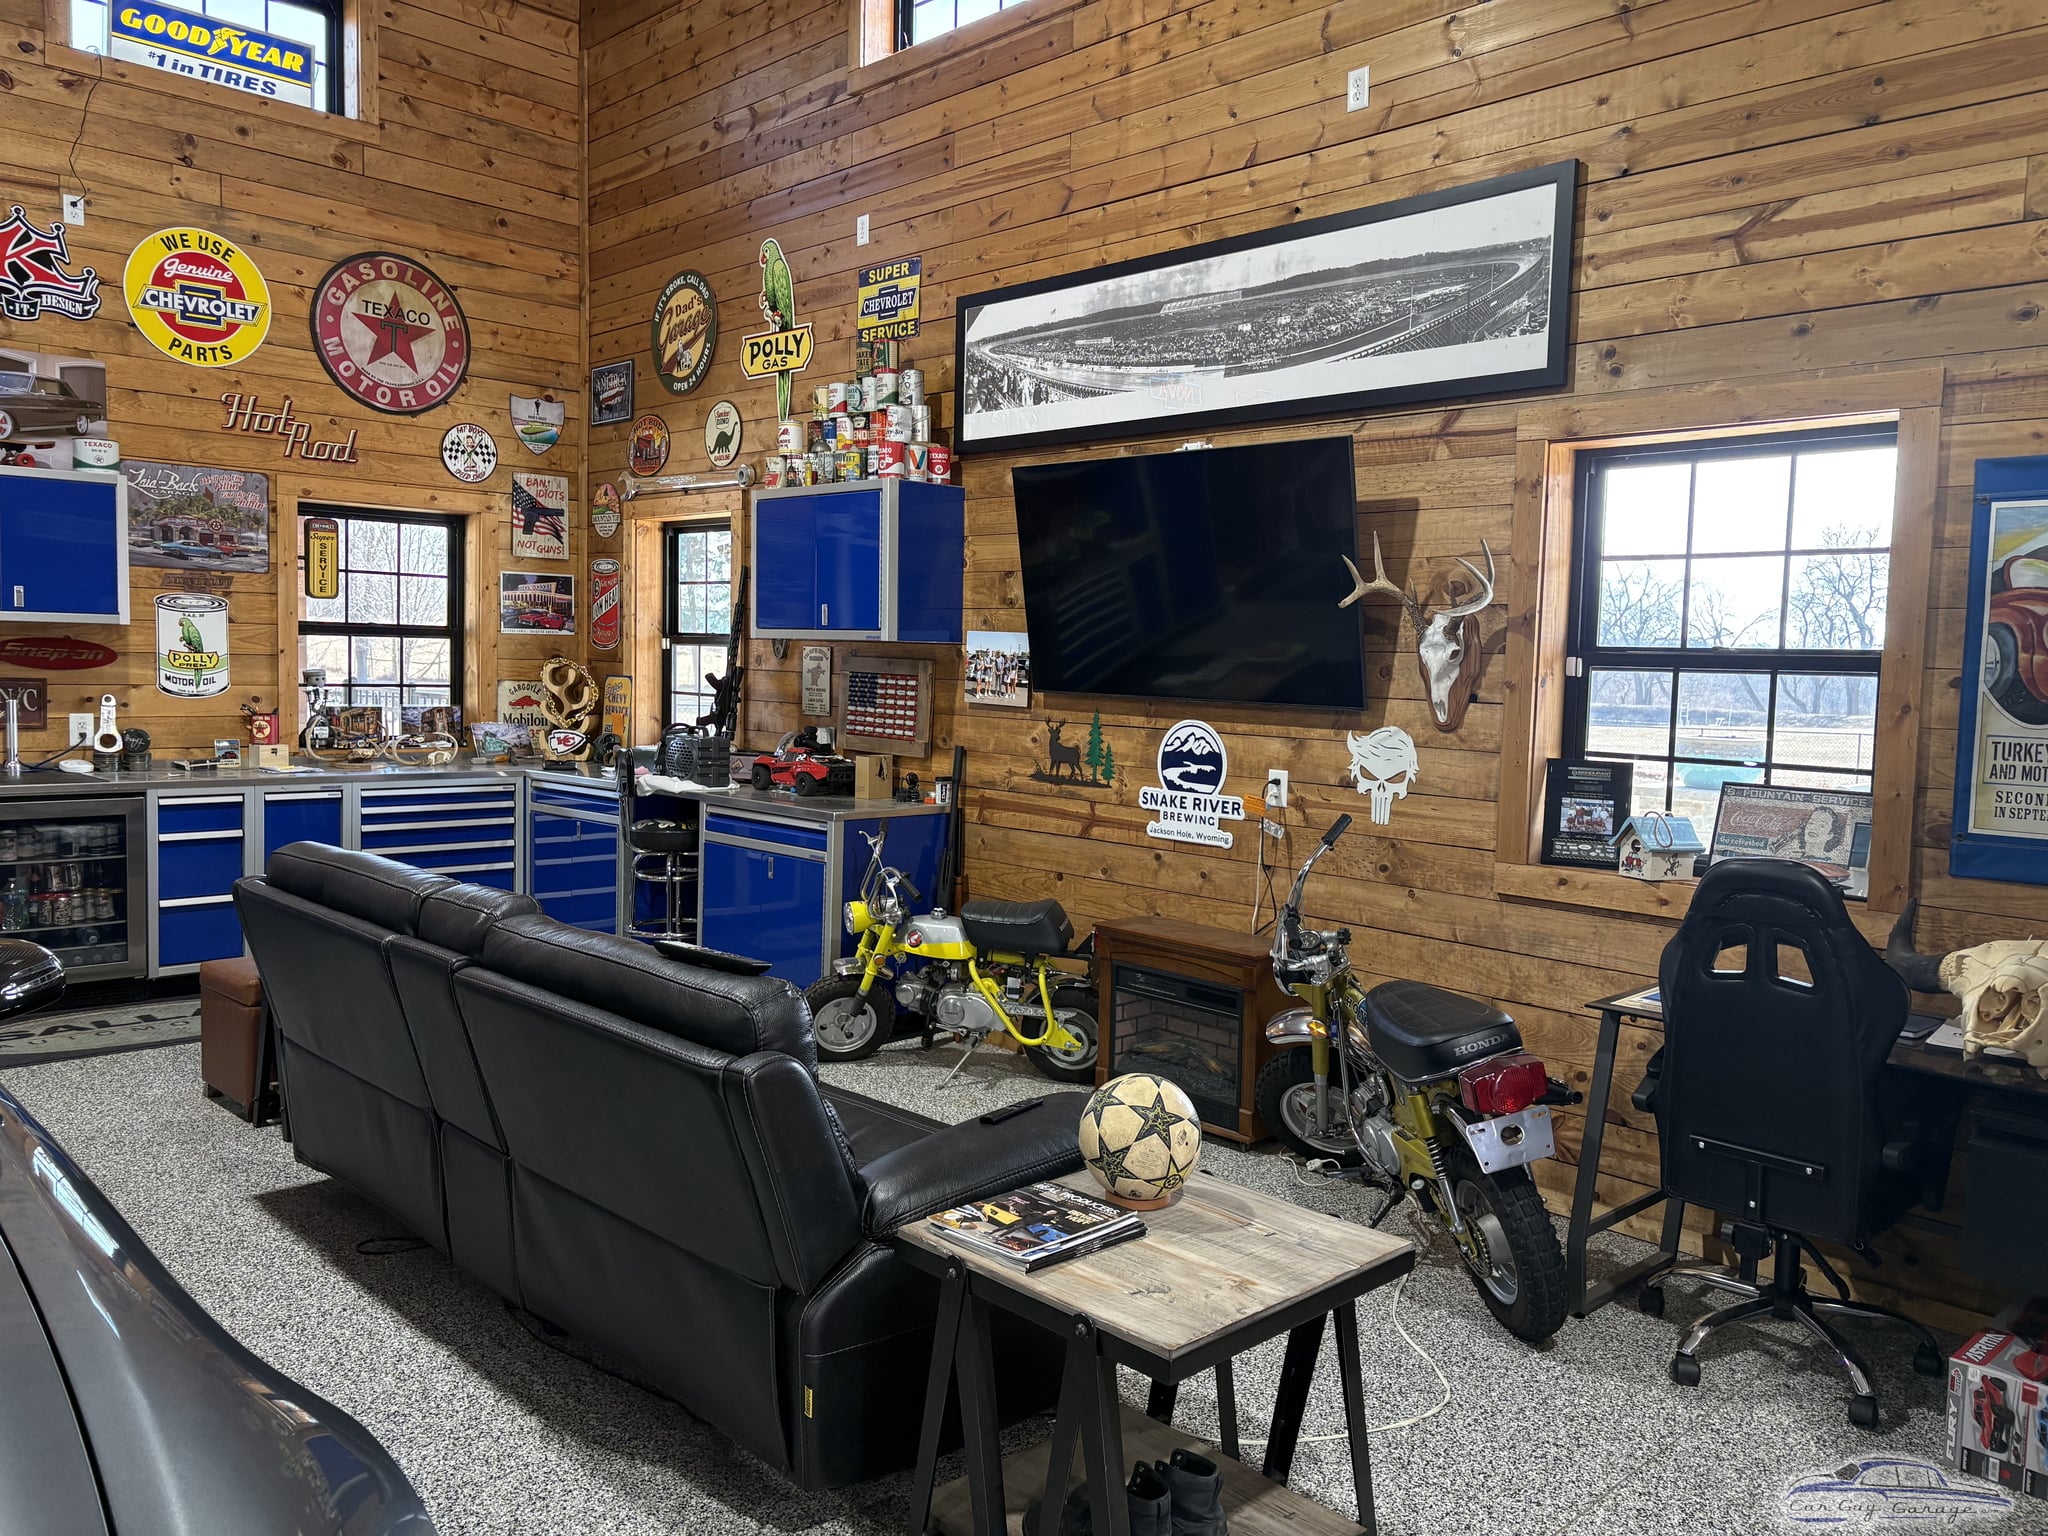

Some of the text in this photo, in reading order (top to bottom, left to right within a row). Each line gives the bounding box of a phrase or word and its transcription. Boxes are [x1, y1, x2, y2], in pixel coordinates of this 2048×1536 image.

[147, 51, 277, 96] #1 in TIRES
[161, 233, 235, 262] WE USE
[164, 258, 233, 282] Genuine
[868, 261, 909, 284] SUPER
[41, 294, 83, 314] DESIGN
[145, 290, 256, 321] CHEVROLET
[327, 261, 460, 331] GASOLINE
[655, 313, 660, 322] IF
[658, 295, 667, 311] IT'S
[687, 275, 699, 284] CALL
[699, 283, 709, 299] DAD
[675, 295, 702, 317] Dad's
[864, 291, 914, 314] CHEVROLET
[15, 303, 29, 316] IT
[362, 300, 430, 325] TEXACO
[657, 304, 713, 352] Garage
[862, 321, 915, 342] SERVICE
[168, 337, 233, 362] PARTS
[749, 332, 805, 367] POLLY
[323, 336, 460, 407] MOTOR OIL
[673, 342, 711, 391] OPEN 24 HOURS
[762, 356, 788, 370] GAS
[221, 393, 294, 435] Hot
[284, 422, 358, 463] Rod
[151, 489, 195, 497] GARAGE
[311, 532, 335, 542] Super
[517, 540, 565, 555] NOT GUNS!
[319, 543, 327, 592] SERVICE
[172, 653, 214, 664] POLLY
[164, 673, 216, 686] MOTOR OIL
[509, 683, 542, 695] GARGOYLE
[1989, 764, 2016, 780] AND
[1142, 792, 1188, 810] SNAKE
[1193, 798, 1241, 816] RIVER
[1743, 789, 1804, 801] FOUNTAIN
[1812, 794, 1868, 807] SERVICE
[1995, 791, 2048, 806] SECON
[1163, 811, 1215, 826] BREWING
[1994, 806, 2048, 821] IN SEPTE
[1149, 825, 1229, 844] Jackson Hole, Wyoming
[1455, 1032, 1509, 1056] HONDA
[1060, 1191, 1121, 1216] PRODUCERS
